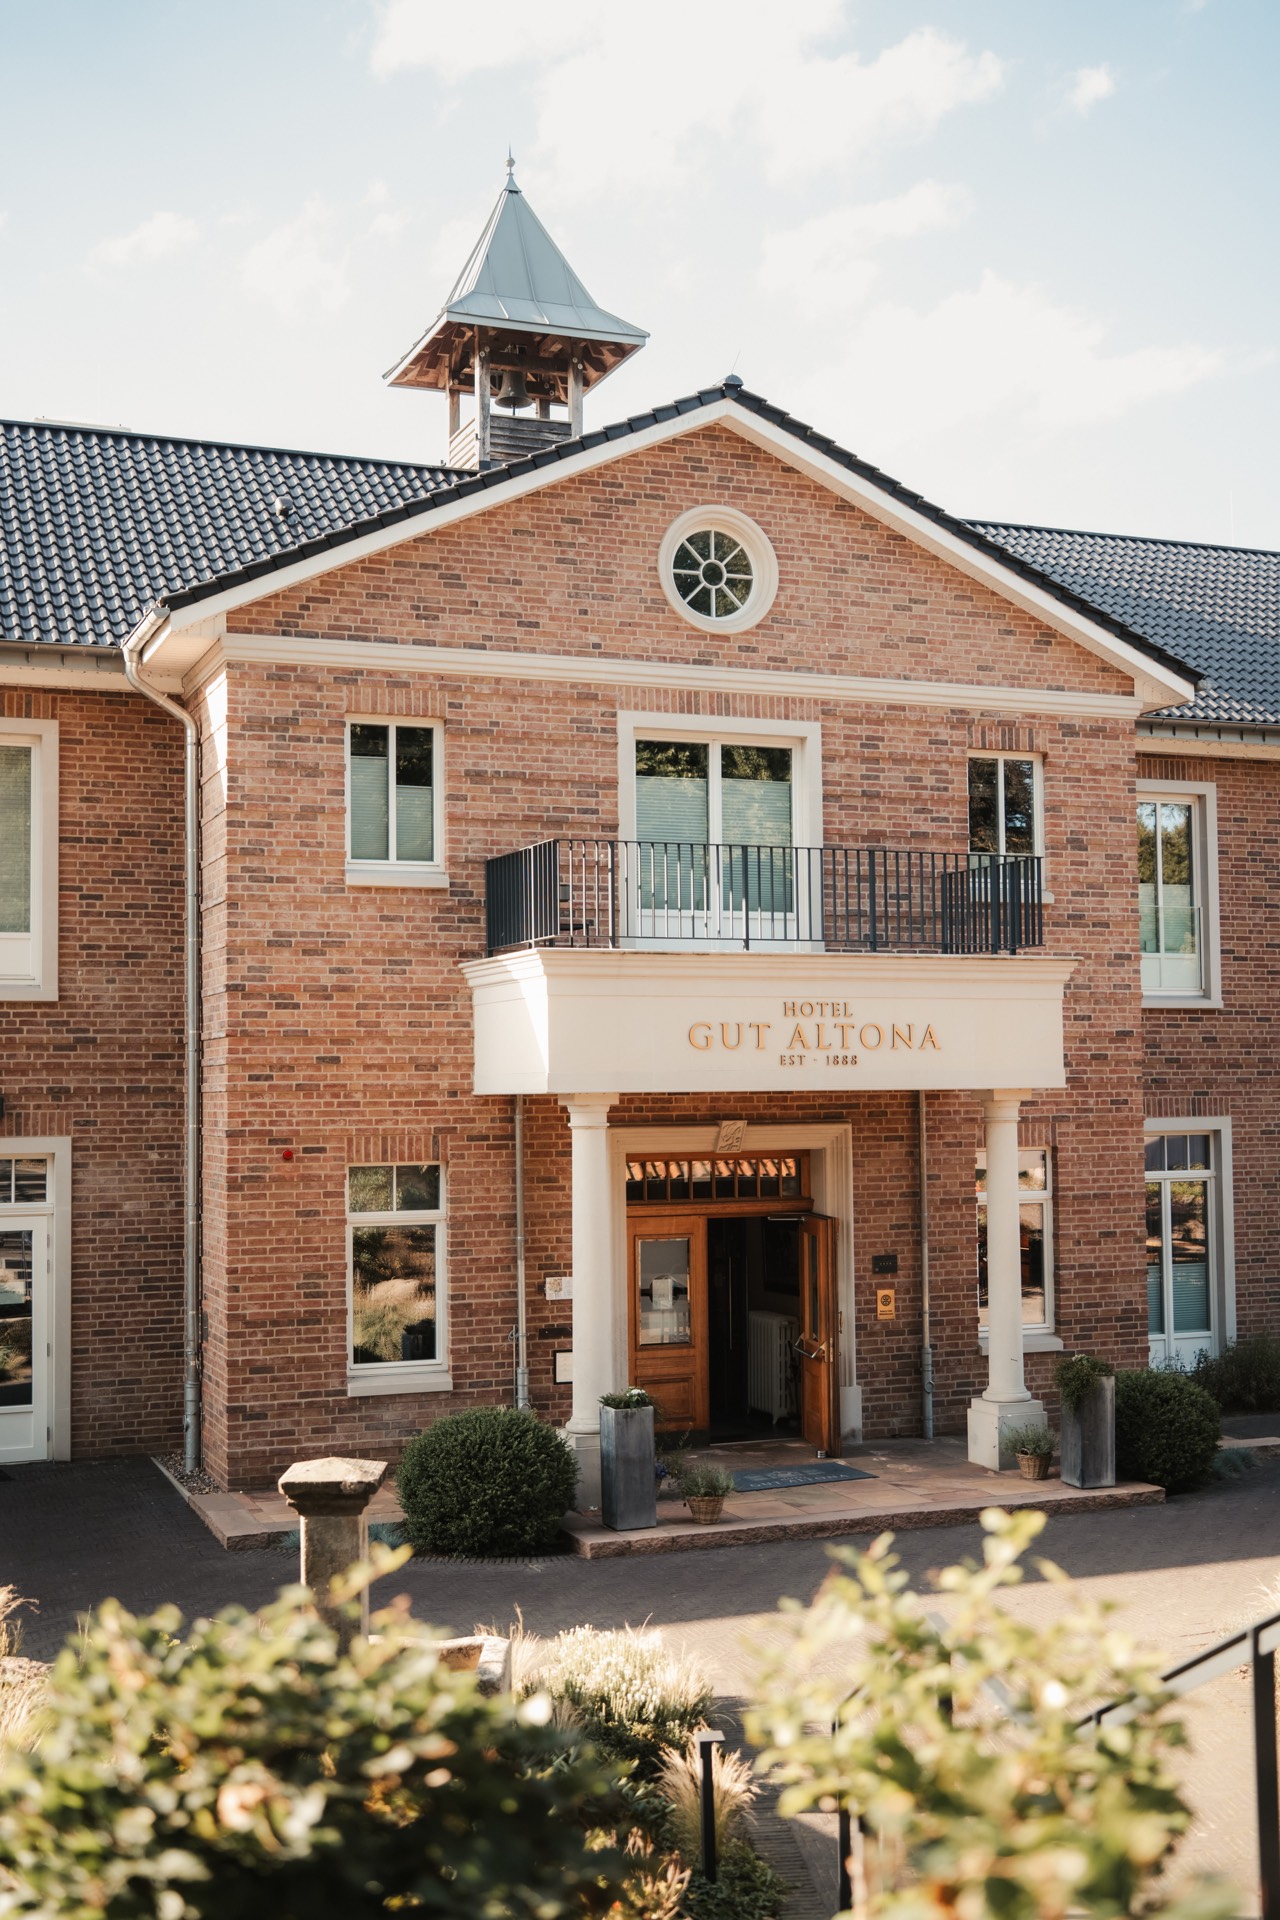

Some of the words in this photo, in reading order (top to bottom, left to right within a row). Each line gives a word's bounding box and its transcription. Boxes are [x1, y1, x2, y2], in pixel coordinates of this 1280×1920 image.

[783, 1001, 853, 1018] HOTEL
[688, 1022, 771, 1051] GUT
[787, 1023, 941, 1051] ALTONA
[780, 1054, 806, 1066] EST
[826, 1055, 858, 1066] 1888
